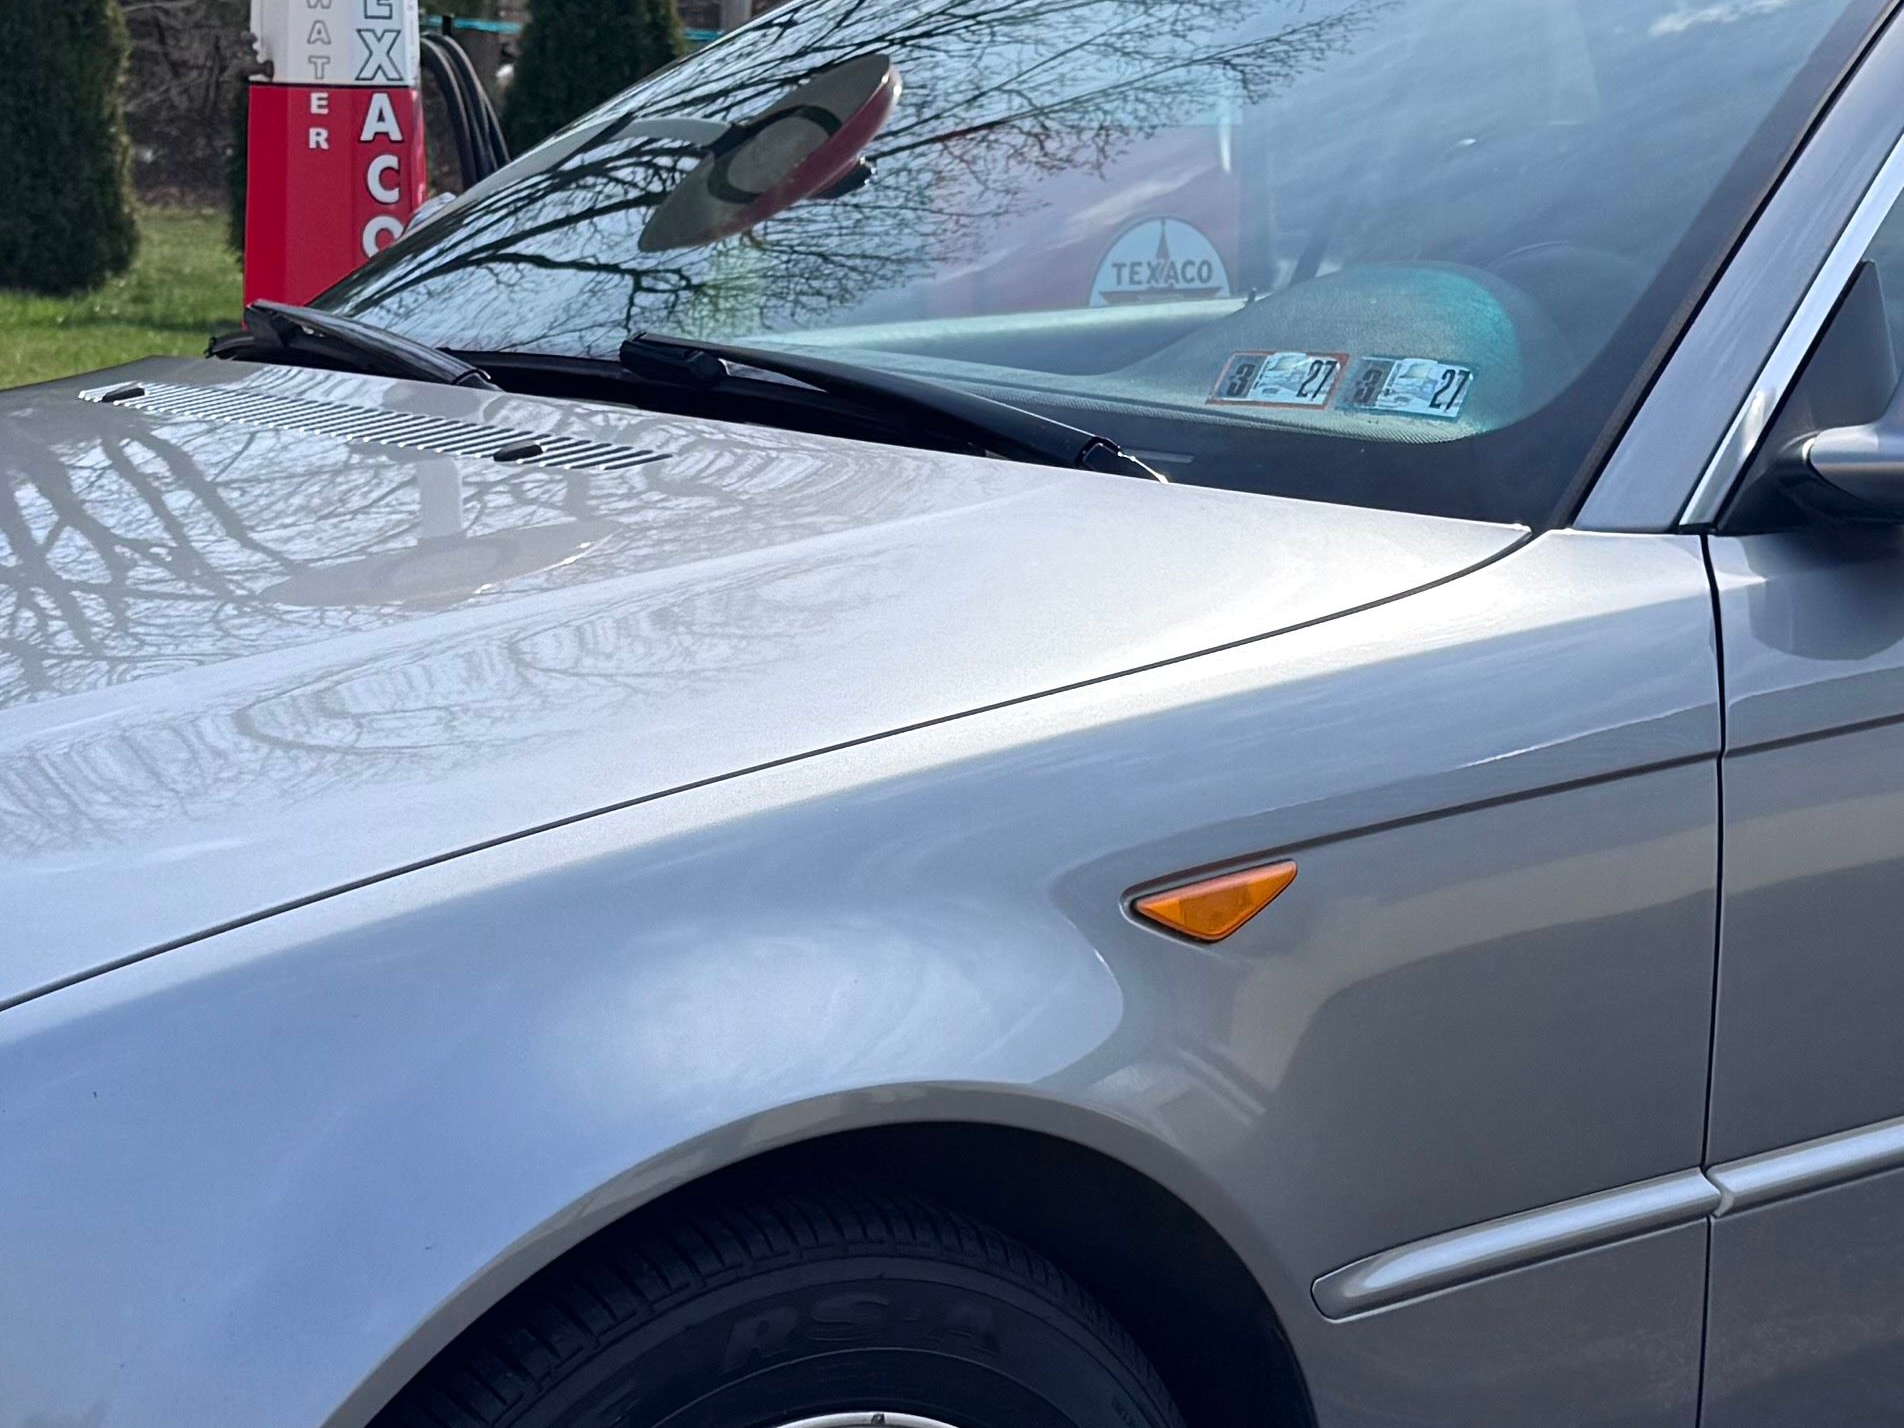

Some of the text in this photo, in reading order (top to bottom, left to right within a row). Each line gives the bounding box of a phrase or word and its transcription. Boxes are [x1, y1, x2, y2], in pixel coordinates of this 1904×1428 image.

[1112, 259, 1213, 286] TEXACO
[1226, 359, 1338, 401] 3 27
[1353, 368, 1471, 410] 3 27
